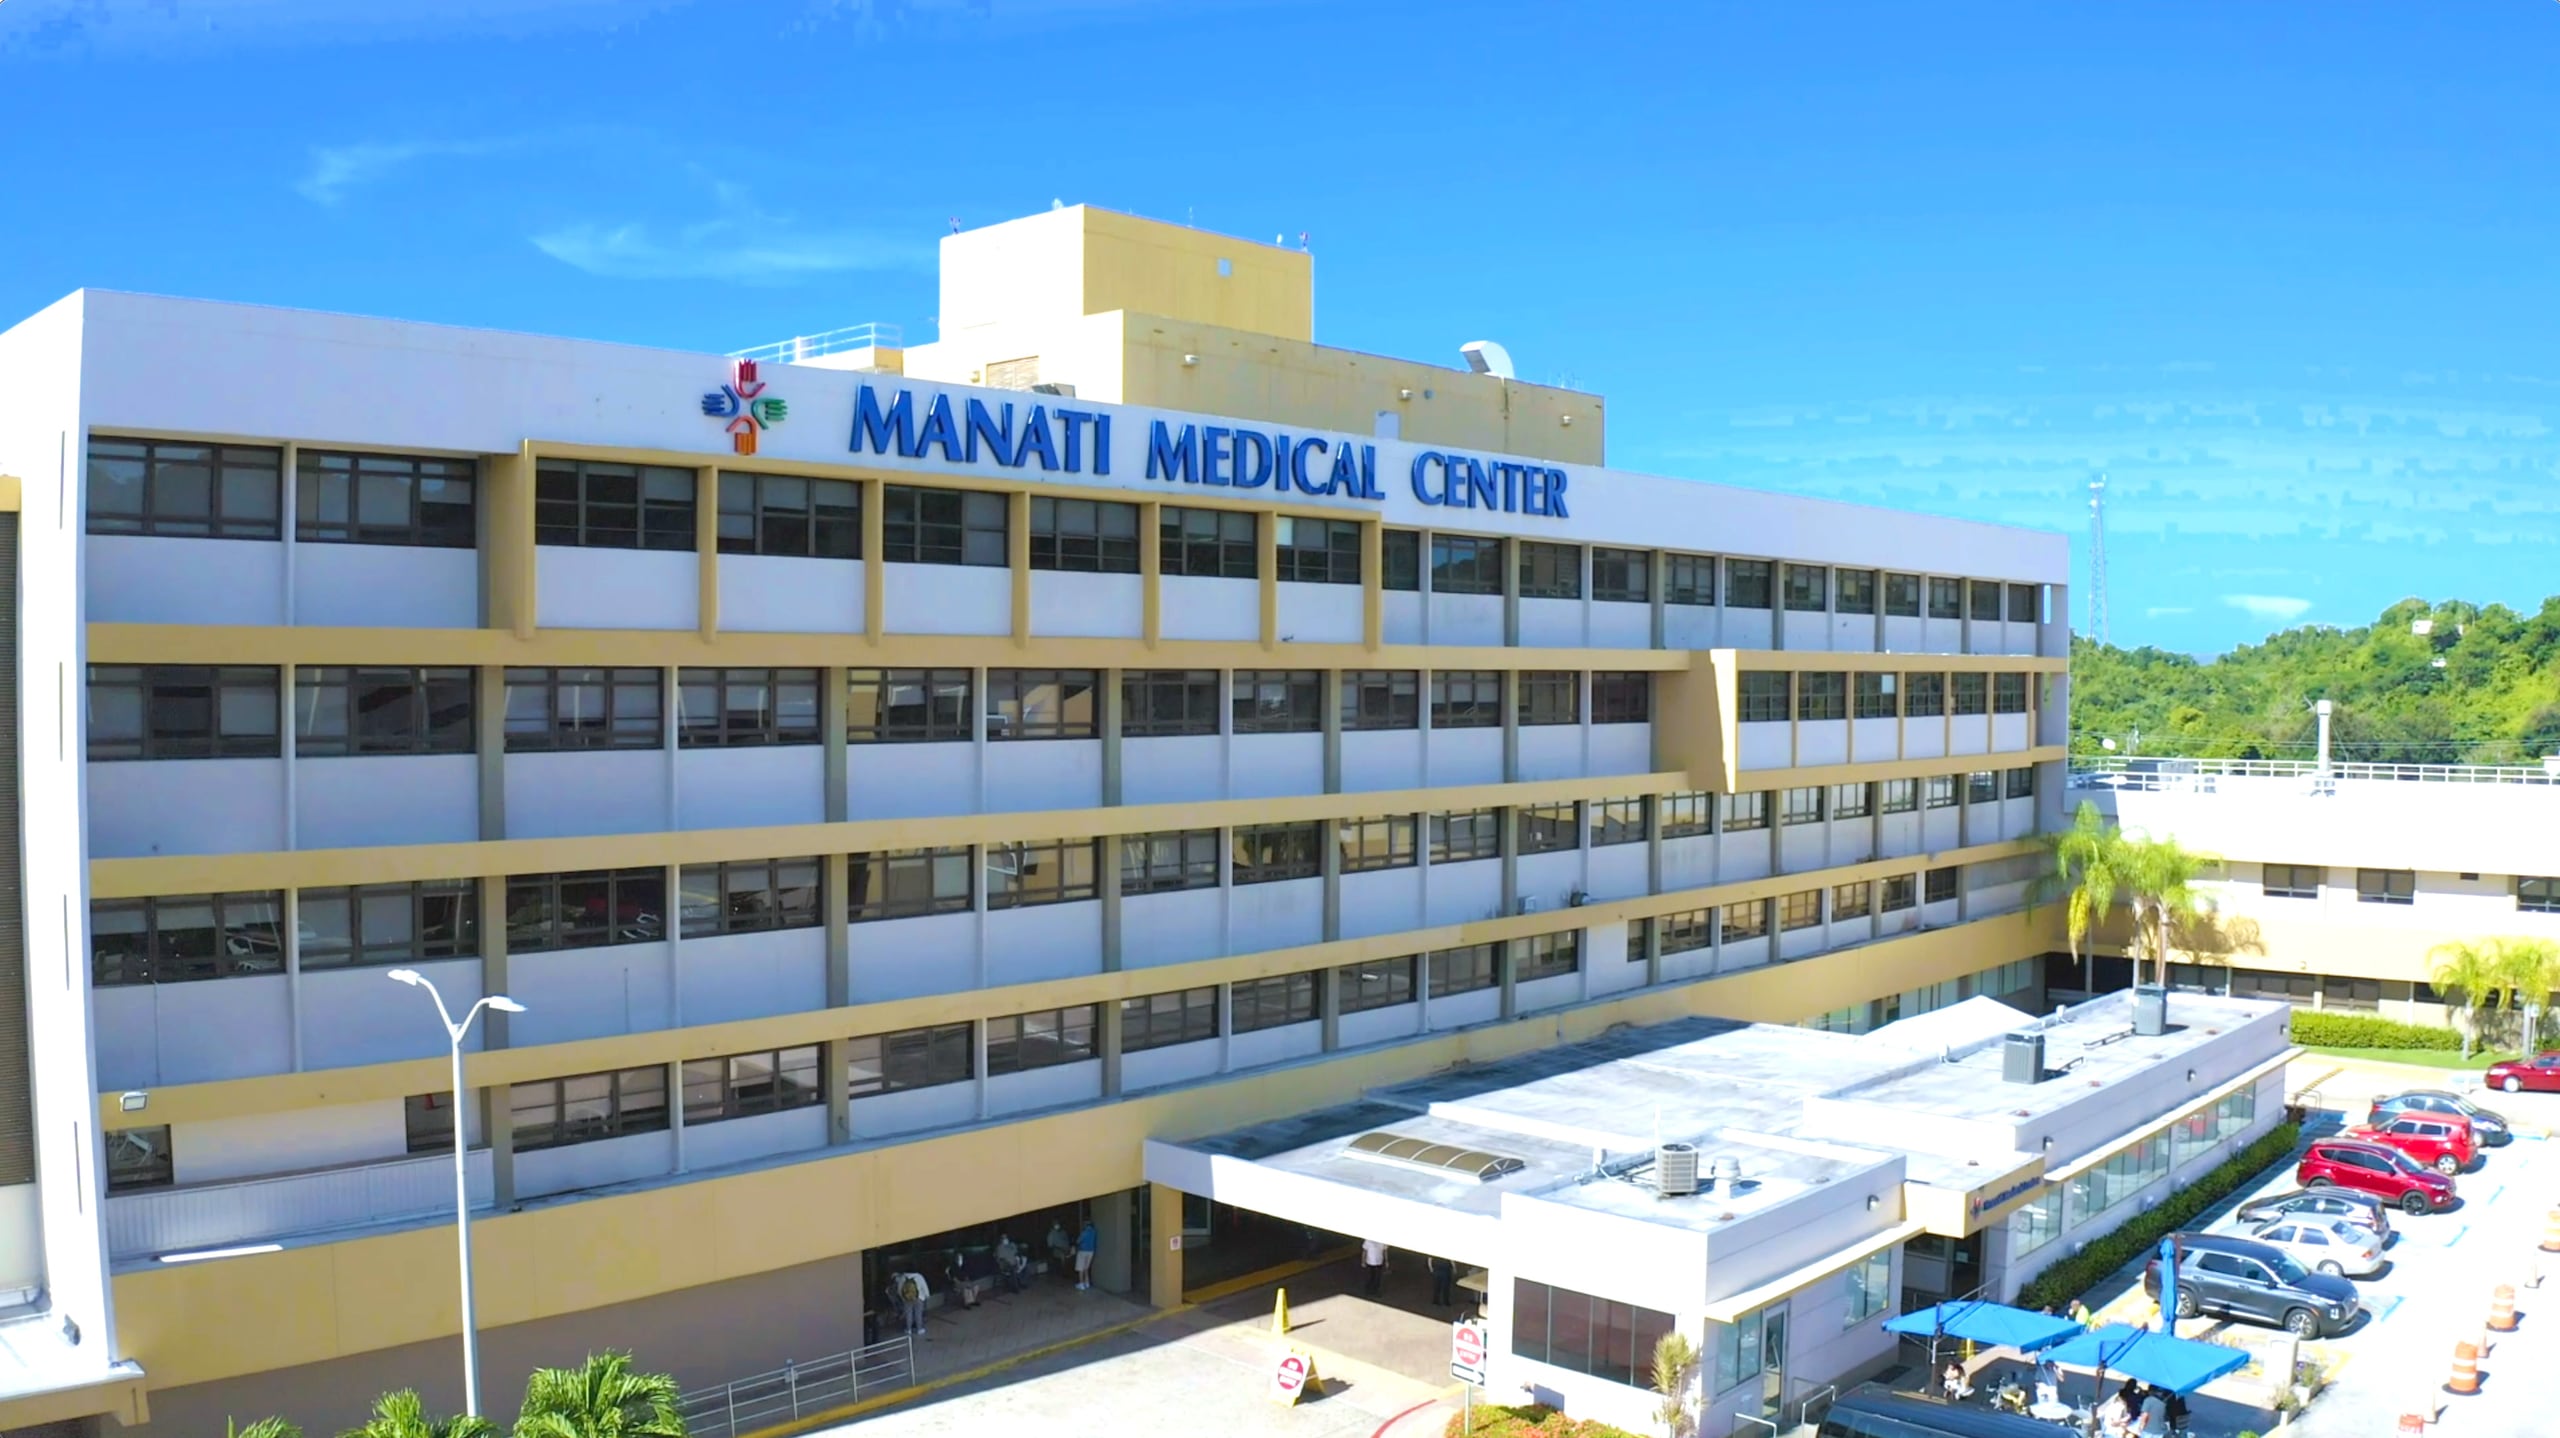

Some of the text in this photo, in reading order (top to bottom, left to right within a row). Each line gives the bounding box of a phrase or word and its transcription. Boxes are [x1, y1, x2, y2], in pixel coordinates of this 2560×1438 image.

[849, 384, 1569, 518] MANATI MEDICAL CENTER
